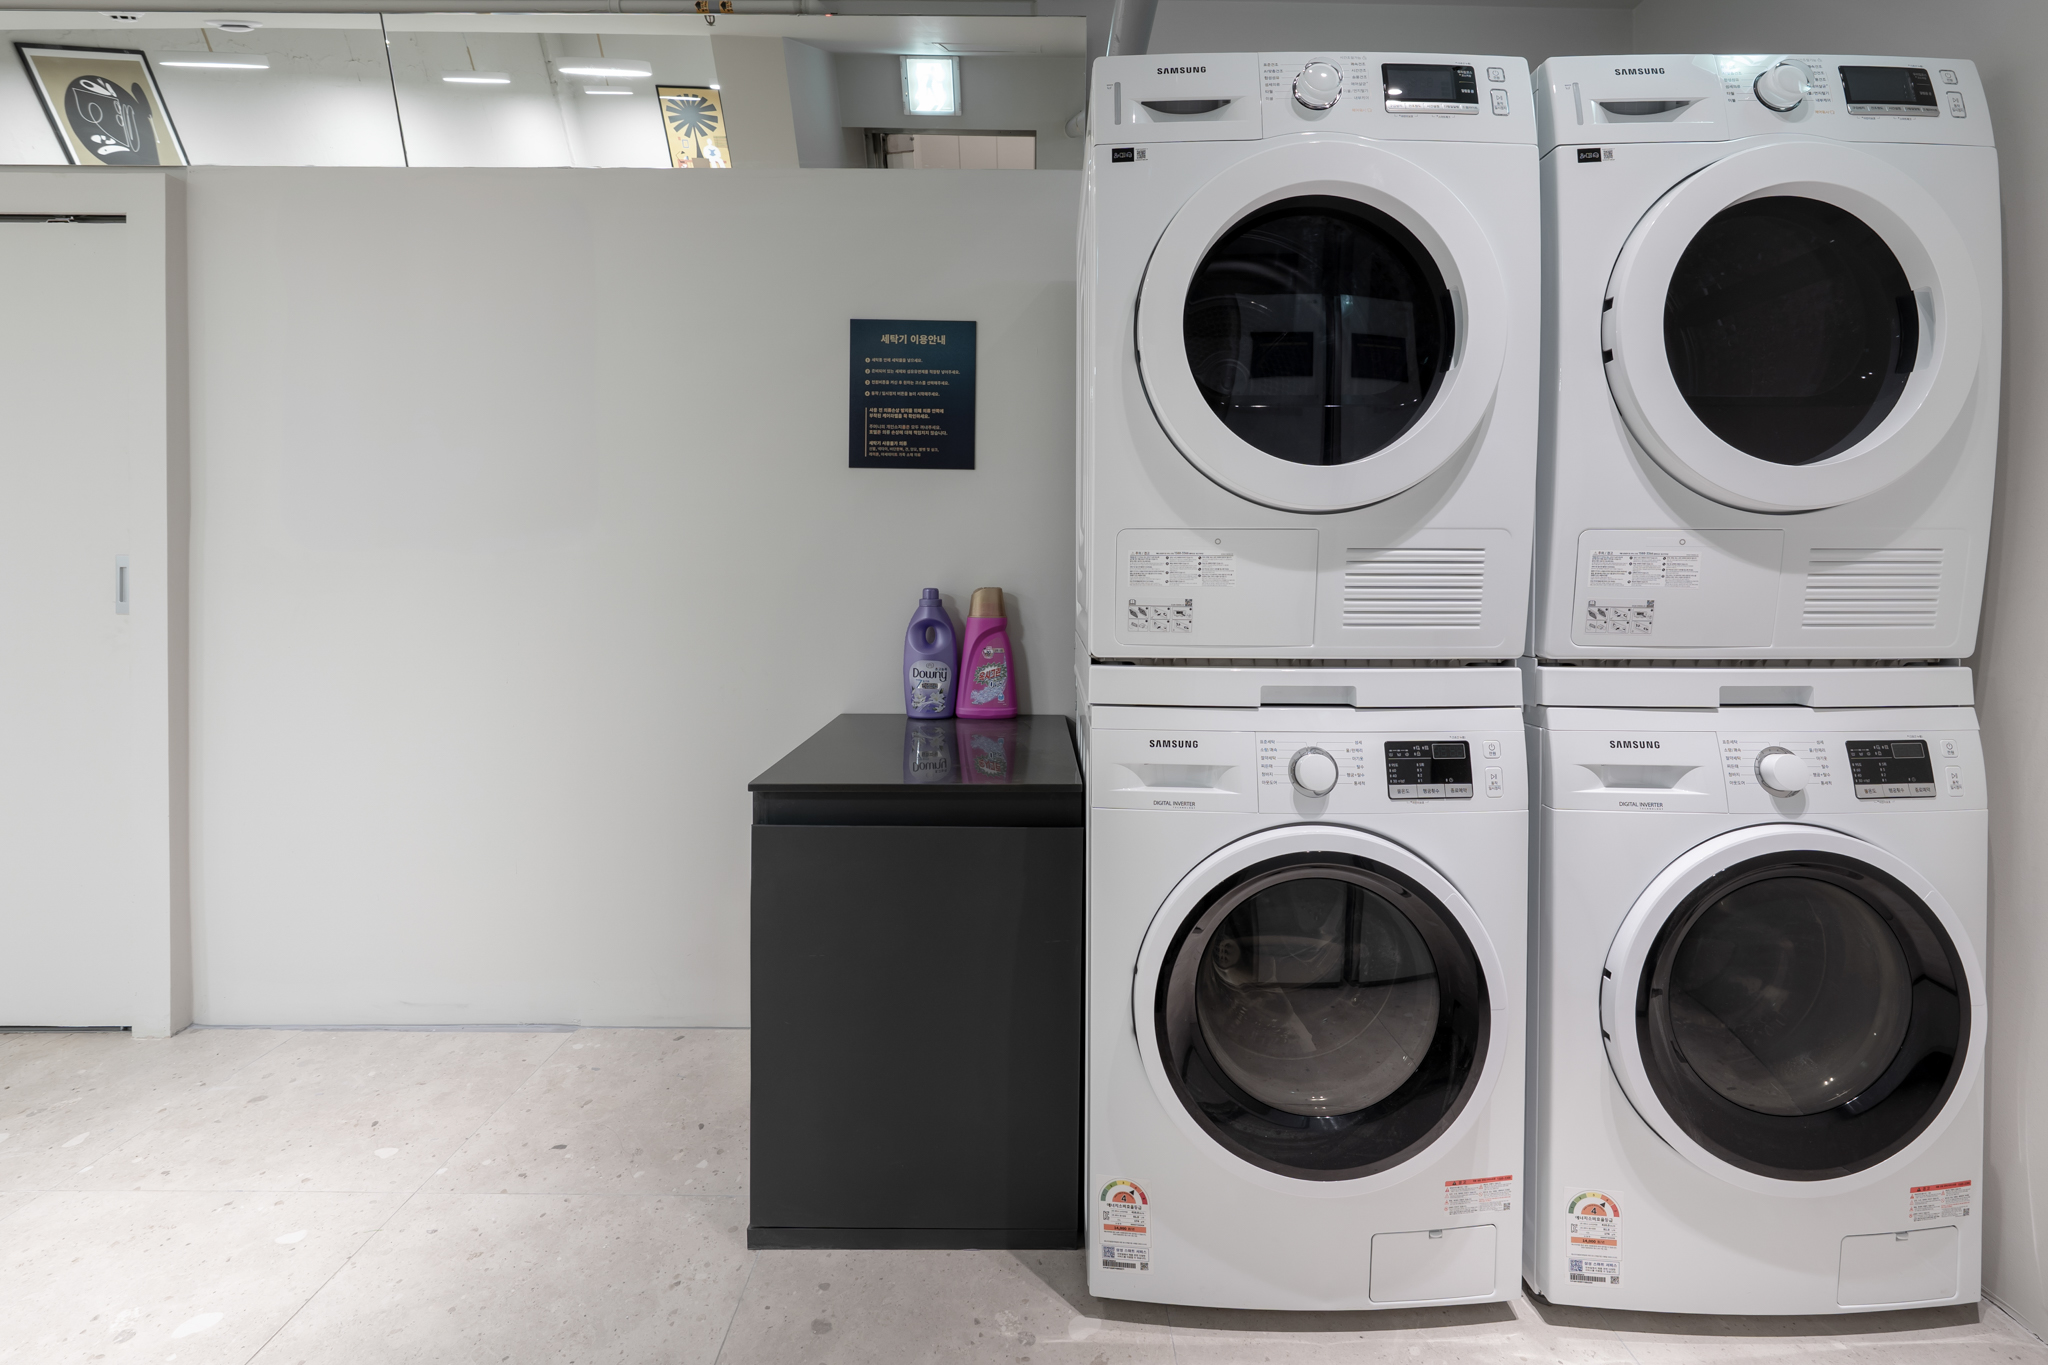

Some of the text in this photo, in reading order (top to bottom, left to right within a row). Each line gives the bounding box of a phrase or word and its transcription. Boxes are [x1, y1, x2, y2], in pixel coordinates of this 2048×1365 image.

[881, 334, 946, 345] 세탁기 이용안내
[913, 668, 947, 682] Downy
[1149, 740, 1199, 748] SAMSUNG
[1610, 740, 1660, 749] SAMSUNG
